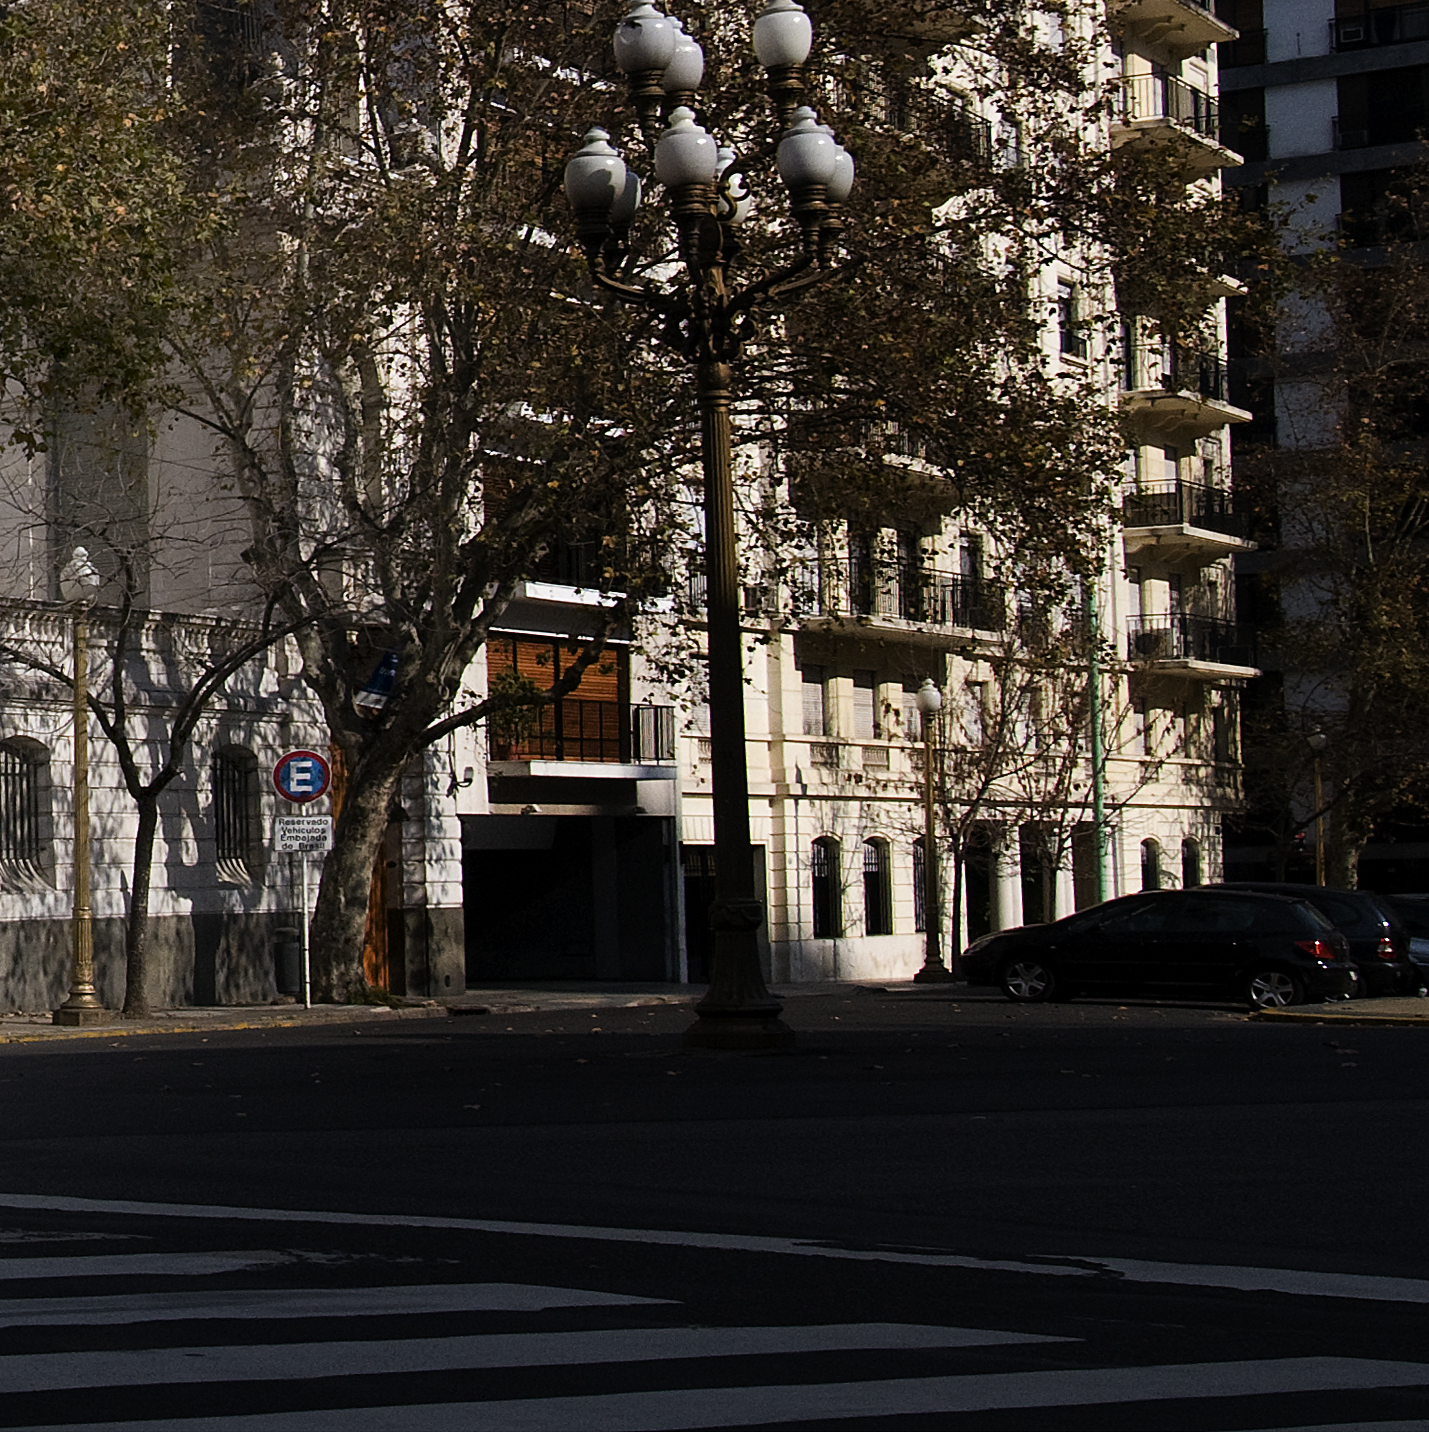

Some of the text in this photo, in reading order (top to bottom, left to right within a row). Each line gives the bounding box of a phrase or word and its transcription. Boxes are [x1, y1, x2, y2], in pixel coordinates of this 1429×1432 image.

[290, 761, 313, 792] E
[278, 818, 329, 826] Reservado
[280, 834, 327, 843] Embajada
